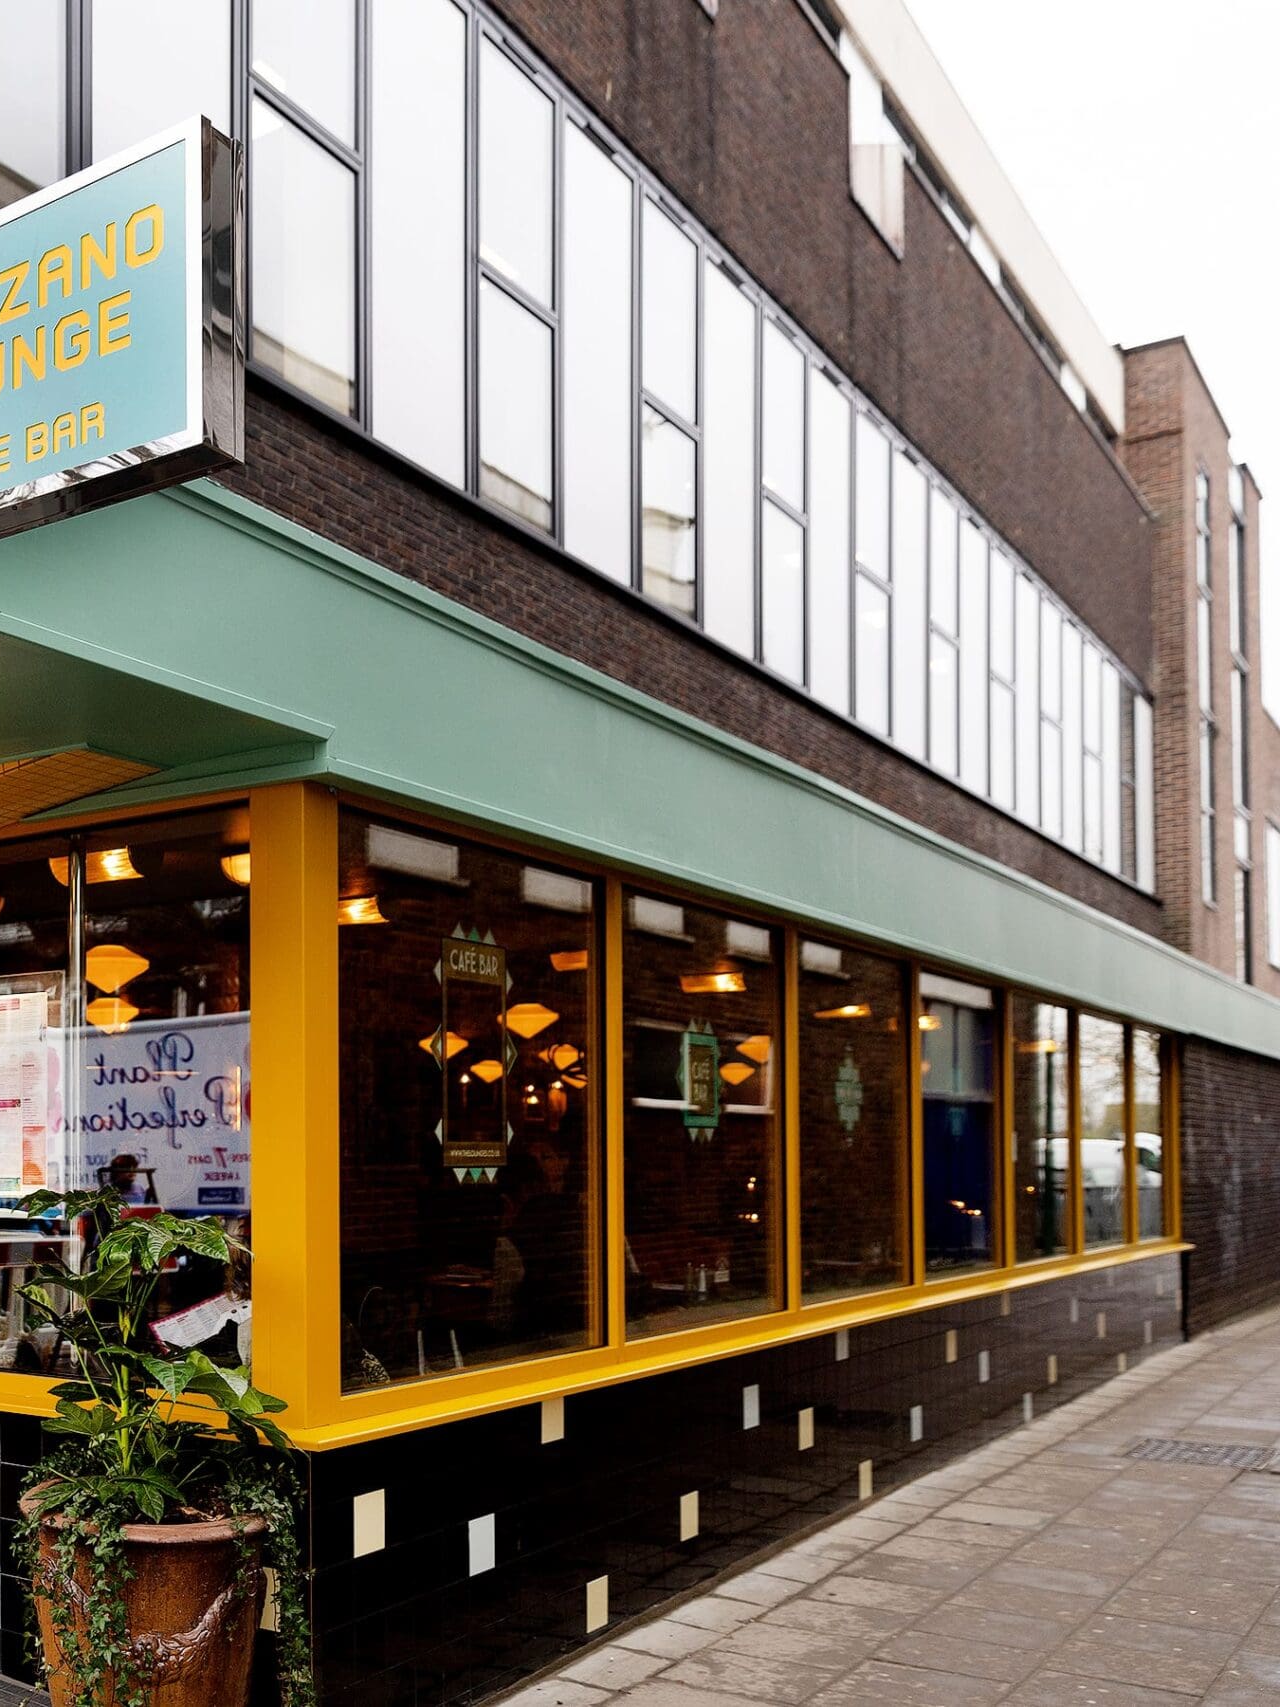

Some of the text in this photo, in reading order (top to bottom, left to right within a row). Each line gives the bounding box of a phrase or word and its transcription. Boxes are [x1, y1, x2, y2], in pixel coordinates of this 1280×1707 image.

[25, 401, 106, 464] BAR
[450, 946, 499, 977] CAFÉ BAR
